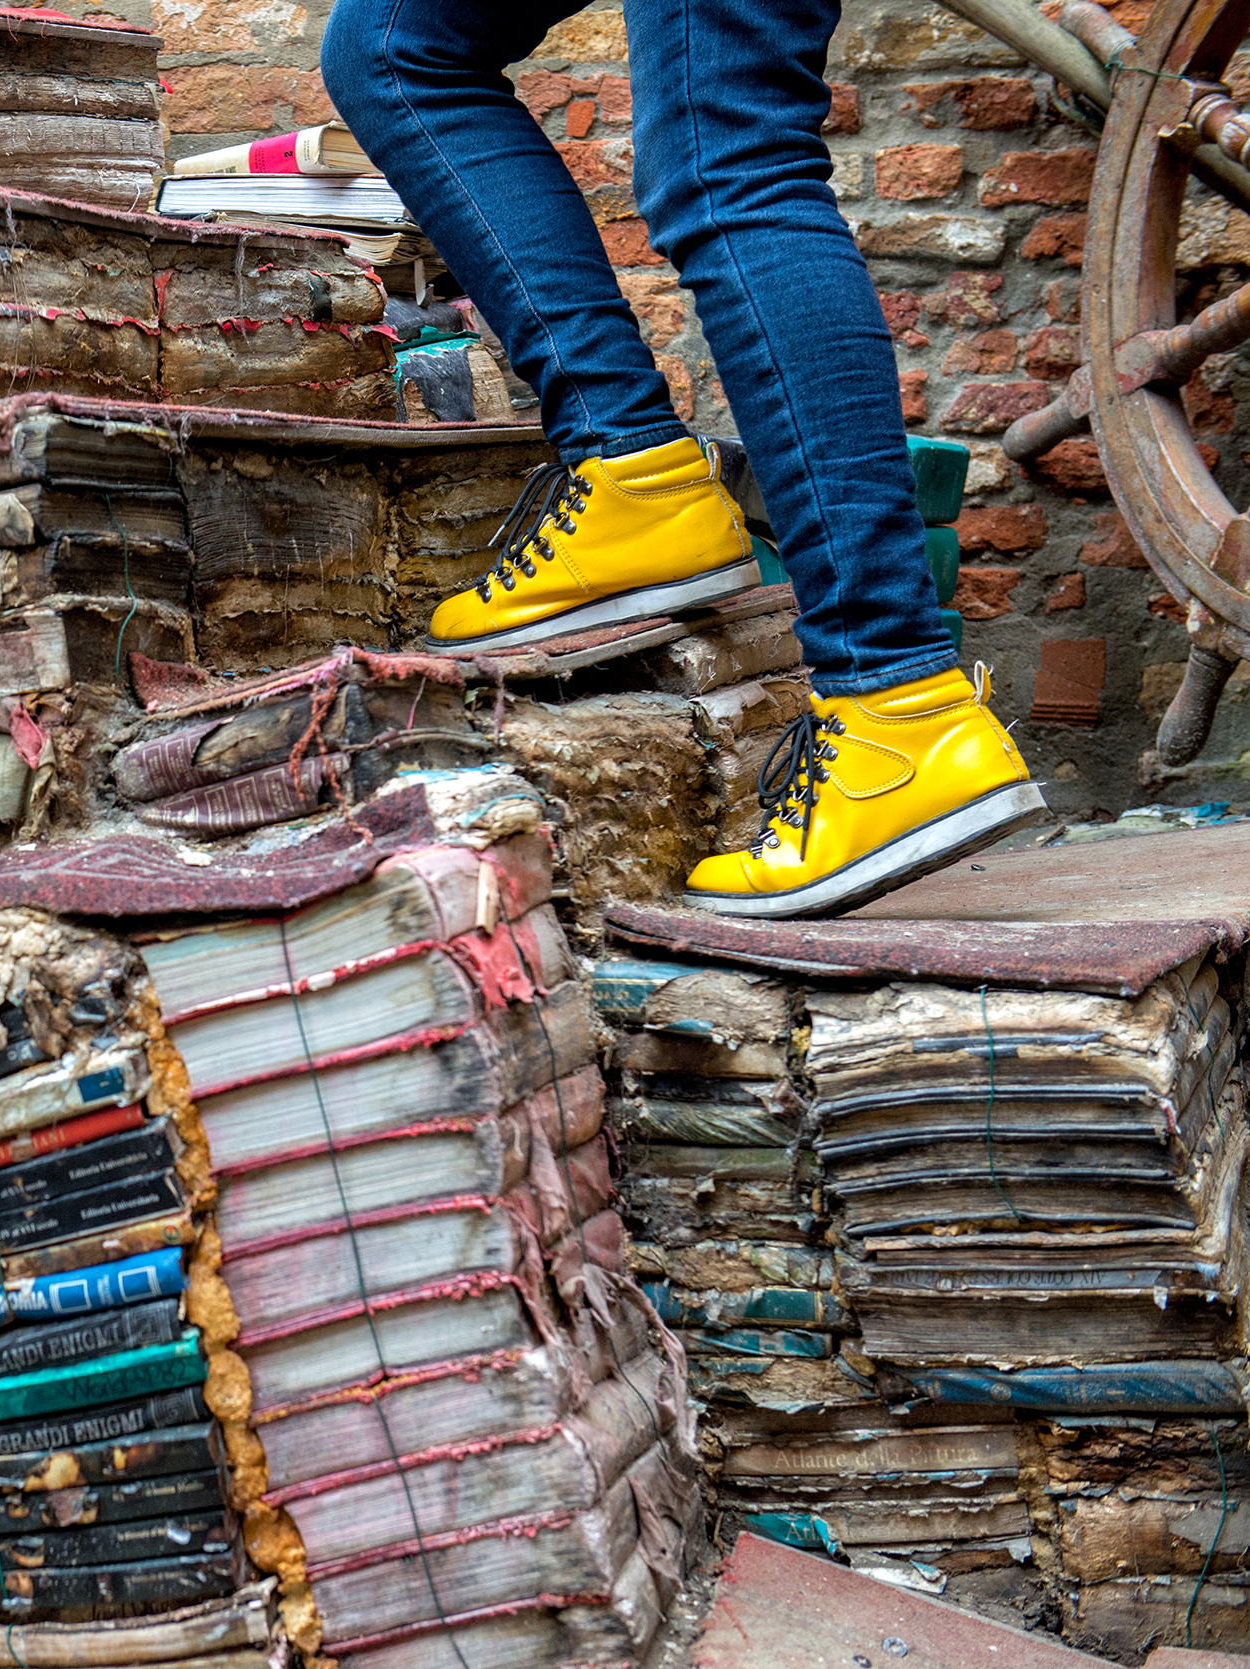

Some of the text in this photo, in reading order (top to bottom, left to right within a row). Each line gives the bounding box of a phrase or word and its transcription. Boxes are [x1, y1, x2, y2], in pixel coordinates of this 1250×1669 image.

[1, 1130, 65, 1159] ITIANI
[69, 1151, 149, 1180] Editoria Universitaria
[25, 1178, 48, 1192] secolo
[81, 1193, 160, 1220] Editoria Universitaria
[11, 1226, 20, 1238] al
[36, 1218, 59, 1231] secolo
[47, 1322, 120, 1361] ENIGMI
[74, 1408, 146, 1442] ENIGMI
[773, 1448, 847, 1470] Atlante
